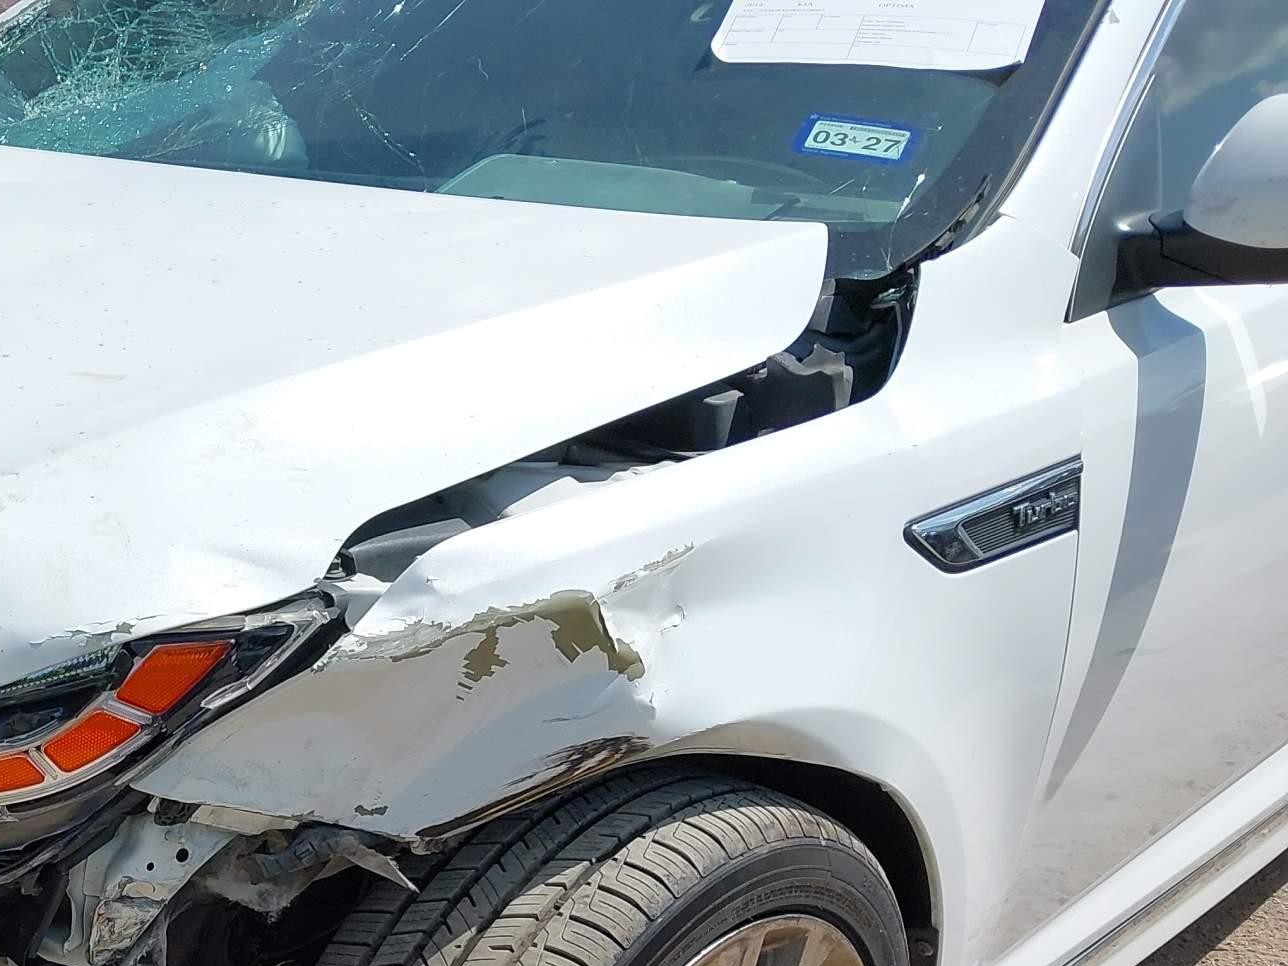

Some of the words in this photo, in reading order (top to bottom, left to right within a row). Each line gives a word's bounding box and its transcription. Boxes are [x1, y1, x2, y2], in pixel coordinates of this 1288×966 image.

[813, 130, 848, 147] 03
[861, 137, 902, 153] 27
[1014, 491, 1078, 527] Turbo
